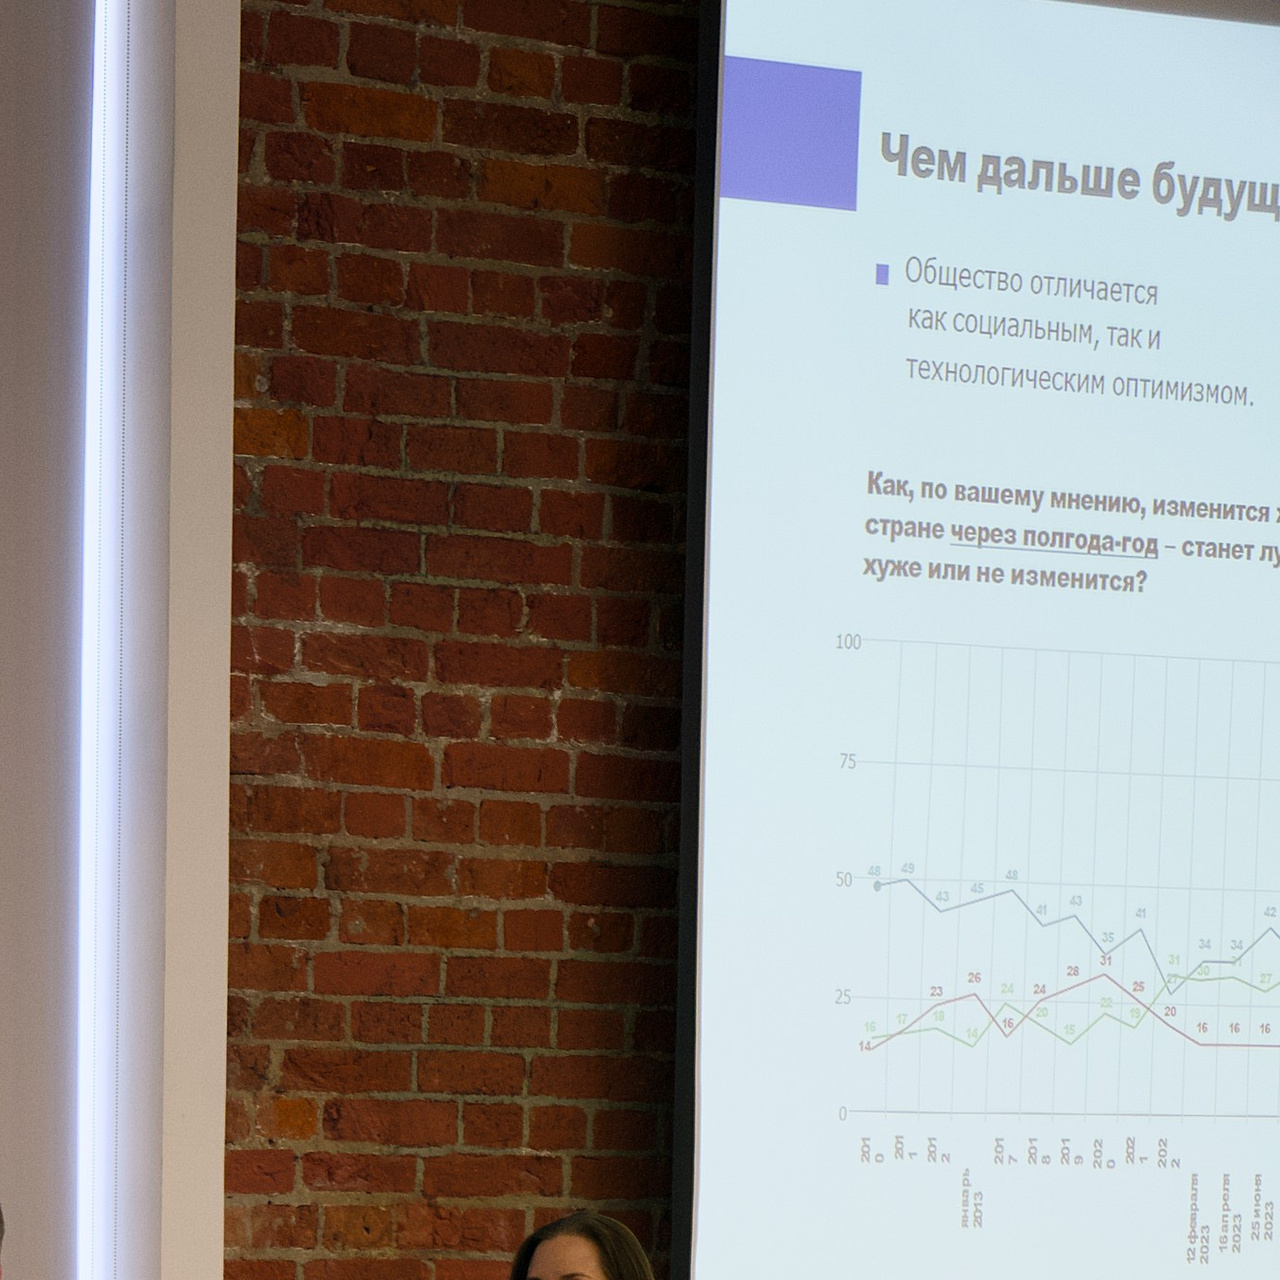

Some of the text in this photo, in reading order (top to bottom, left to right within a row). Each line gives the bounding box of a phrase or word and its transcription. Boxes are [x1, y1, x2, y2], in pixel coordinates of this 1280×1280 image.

[881, 131, 1280, 222] Чем дальше будущ
[906, 256, 1159, 306] Общество отличается
[908, 306, 1162, 352] как социальным, так и
[907, 357, 1255, 407] технологическим оптимизмом.
[867, 470, 915, 503] Как,
[920, 480, 948, 500] по
[954, 482, 1044, 513] вашему
[1050, 490, 1146, 520] мнению,
[1152, 498, 1270, 522] изменится
[865, 517, 945, 545] стране
[950, 524, 1017, 547] через
[1022, 529, 1159, 559] полгода-год
[1181, 539, 1255, 560] станет
[863, 557, 1148, 593] хуже или не изменится?
[835, 633, 862, 650] 100
[840, 752, 857, 770] 75
[836, 871, 853, 889] 50
[1099, 954, 1112, 966] 31
[967, 971, 982, 984] 26
[1132, 980, 1145, 992] 25
[835, 988, 852, 1006] 25
[930, 985, 944, 997] 23
[1033, 983, 1047, 995] 24
[1164, 1005, 1177, 1017] 20
[1002, 1017, 1014, 1029] 16
[1196, 1021, 1208, 1034] 16
[1228, 1022, 1241, 1034] 16
[1259, 1022, 1271, 1034] 16
[838, 1105, 848, 1122] 0
[961, 1167, 972, 1229] январь
[1251, 1173, 1263, 1241] 25 июня
[1186, 1173, 1199, 1265] 12 февраля
[1263, 1200, 1275, 1241] 2023
[1232, 1213, 1243, 1254] 2023
[1199, 1224, 1210, 1265] 2023
